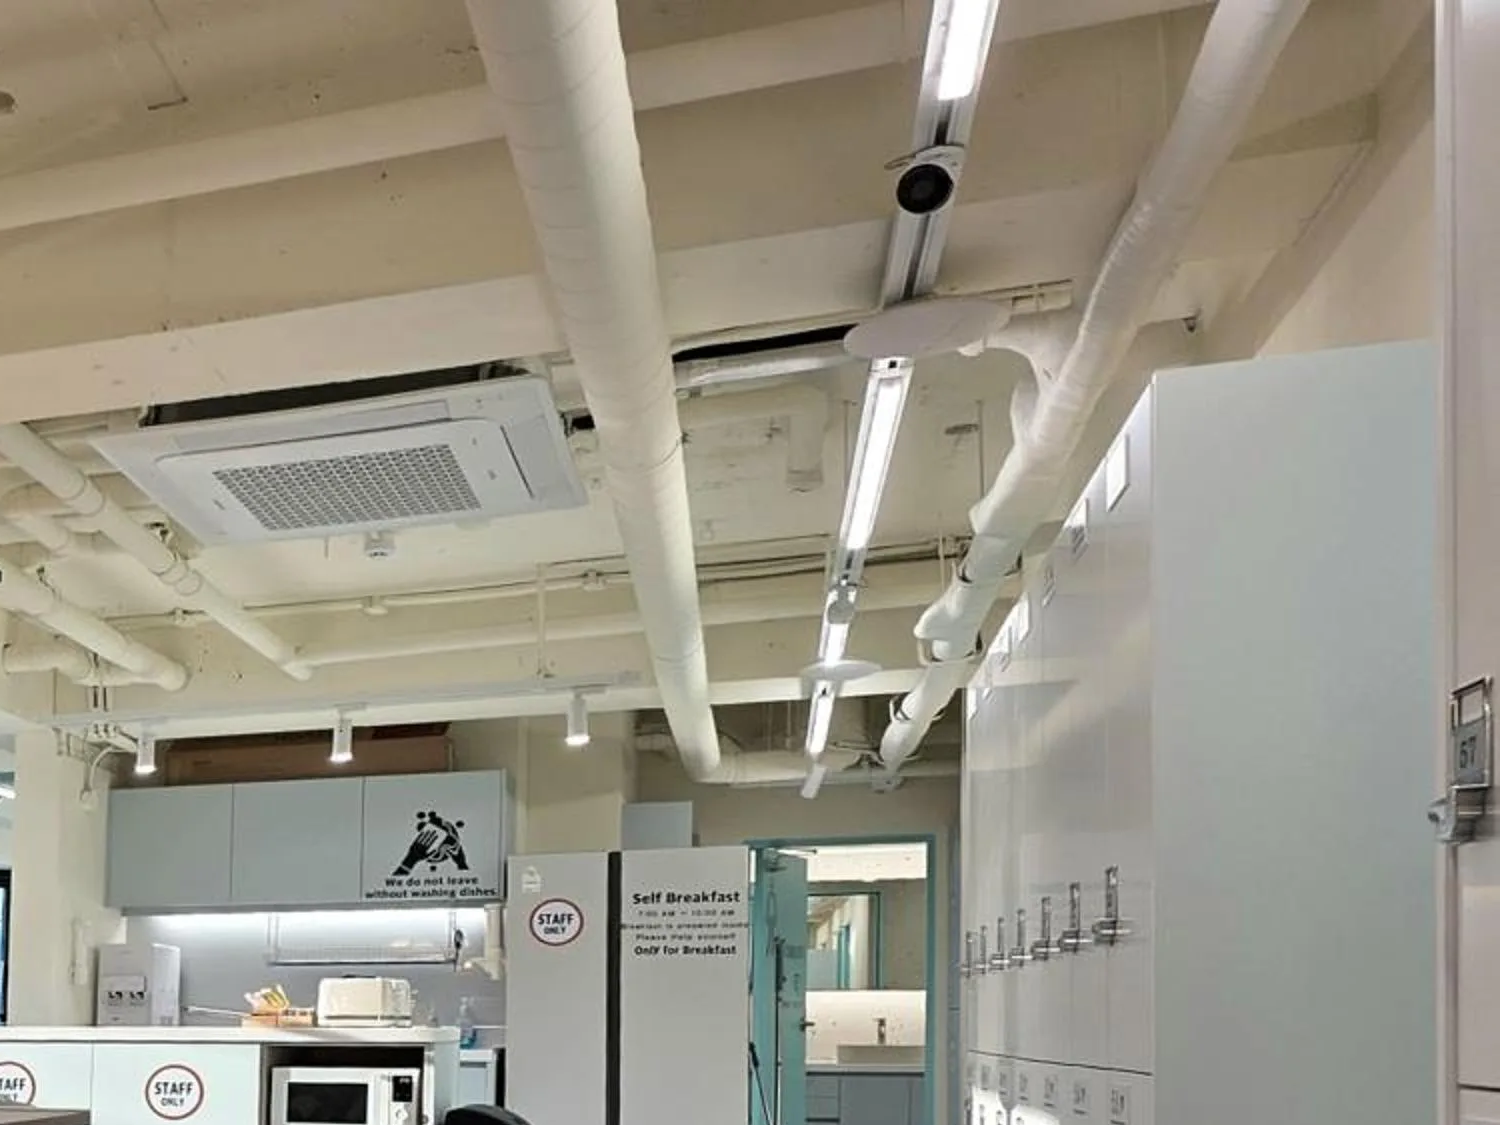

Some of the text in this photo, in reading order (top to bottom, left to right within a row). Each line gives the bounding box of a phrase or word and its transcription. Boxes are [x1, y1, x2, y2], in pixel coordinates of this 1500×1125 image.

[385, 876, 478, 887] We do not leave
[365, 889, 407, 898] without
[411, 888, 456, 898] washing
[632, 891, 740, 905] Self Breakfast
[538, 913, 574, 925] STAFF
[543, 926, 566, 935] ONLY
[663, 945, 679, 955] for
[682, 944, 737, 955] Breakfast
[154, 1081, 194, 1096] STAFF
[160, 1097, 185, 1107] ONLY
